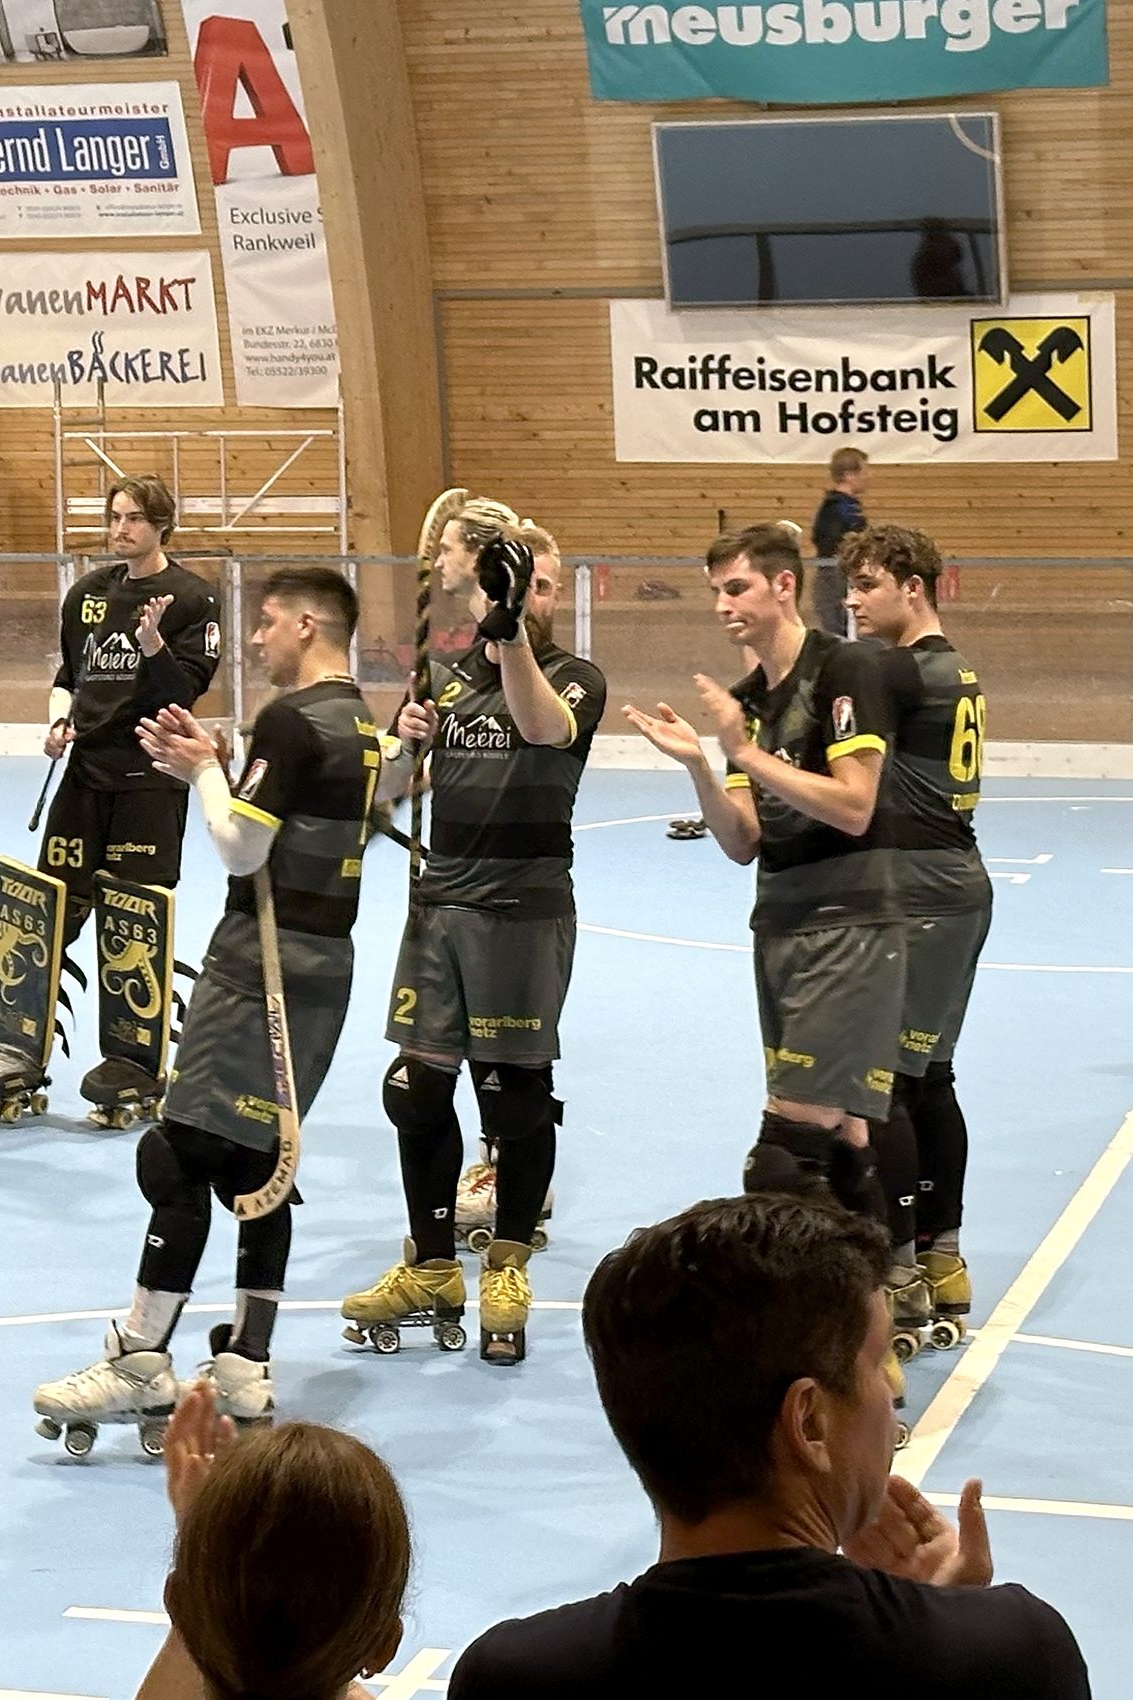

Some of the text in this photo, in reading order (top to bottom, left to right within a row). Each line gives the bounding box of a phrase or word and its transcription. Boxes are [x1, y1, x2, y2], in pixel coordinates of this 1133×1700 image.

[603, 0, 1078, 51] meusburger
[55, 127, 151, 177] Langer
[53, 184, 77, 195] Gas
[89, 183, 122, 195] Solar
[134, 182, 180, 194] Sanitär
[230, 207, 313, 225] Exclusive
[233, 232, 316, 251] Rankweil
[255, 325, 274, 335] EKZ
[276, 326, 310, 335] Merkur
[634, 355, 958, 393] Raiffeisenbank
[693, 398, 960, 443] am Hofsteig
[81, 599, 107, 624] 63
[83, 632, 142, 671] Meierei
[437, 681, 463, 708] 2
[440, 713, 512, 749] Meierei
[47, 835, 83, 868] 63
[394, 987, 417, 1026] 2
